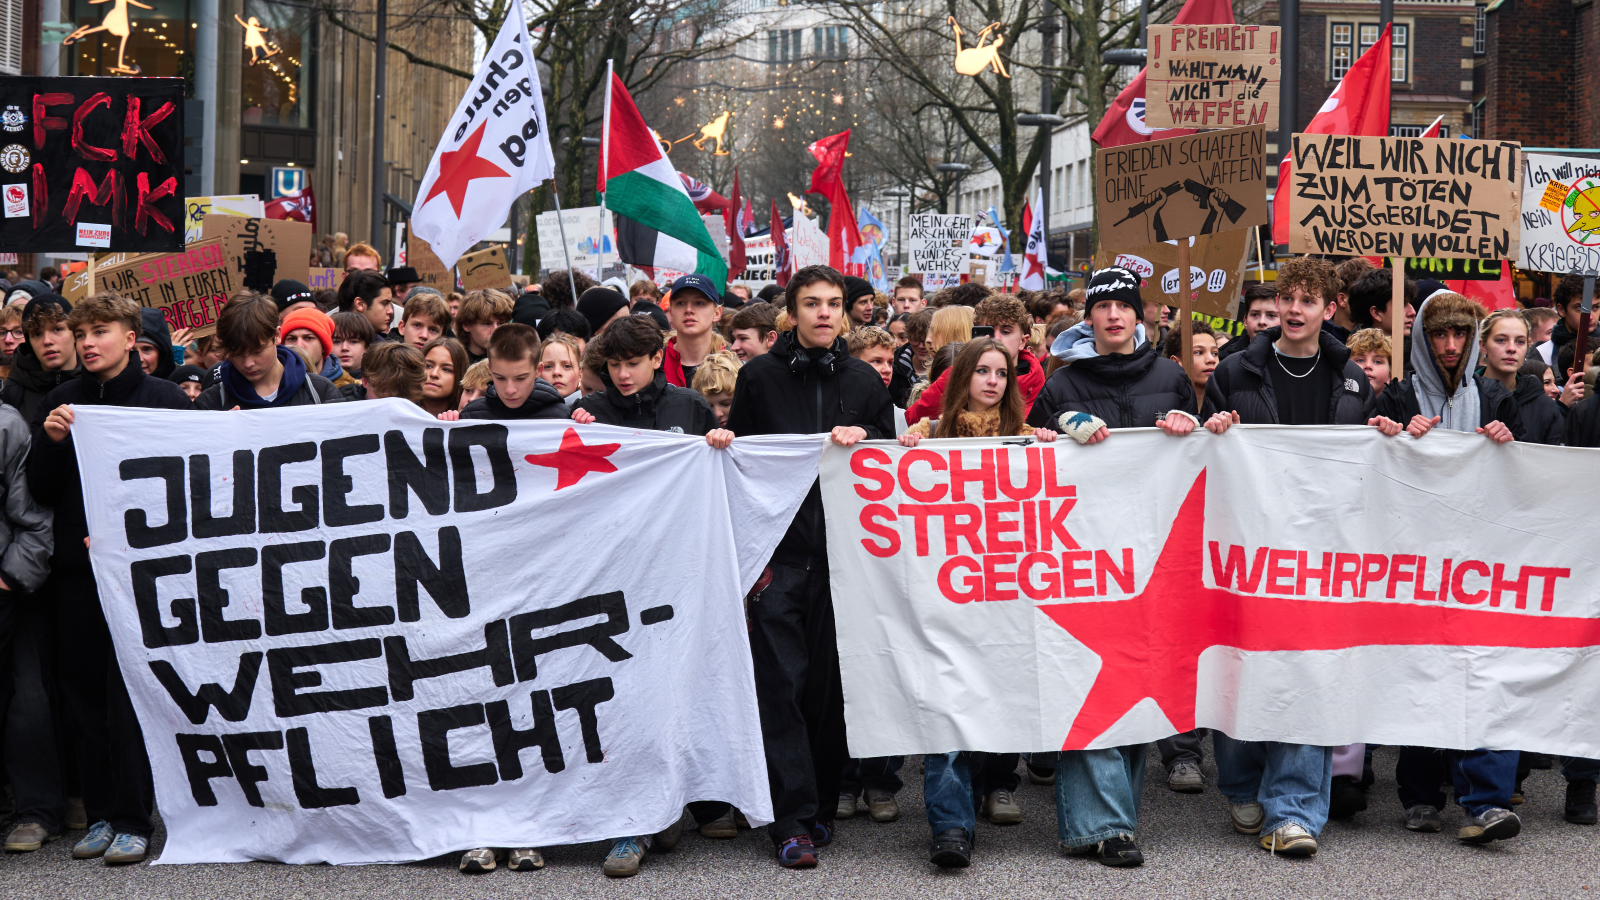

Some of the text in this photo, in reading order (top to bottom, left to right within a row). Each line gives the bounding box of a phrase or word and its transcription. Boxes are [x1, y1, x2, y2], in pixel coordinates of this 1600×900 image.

[1171, 26, 1260, 52] FREIHEIT
[1169, 80, 1230, 102] NICHT
[33, 92, 177, 166] FCK
[1169, 101, 1269, 125] WAFFEN
[1104, 128, 1264, 177] FRIEDEN SCHAFFEN
[1292, 134, 1522, 183] WEIL WIR NICHT
[278, 170, 300, 196] U
[1105, 157, 1263, 203] OHNE WAFFEN
[1295, 173, 1473, 206] ZUM TÖTEN
[1527, 159, 1552, 188] Ich
[1575, 164, 1600, 179] nich
[1550, 179, 1569, 192] KRIEG
[32, 162, 178, 237] IMK
[910, 227, 970, 240] ARSCH NICHT
[911, 214, 971, 229] MEIN GEHT
[1299, 203, 1500, 236] AUSGEBILDET
[913, 248, 967, 262] BUNDES-
[924, 239, 949, 250] ZUR
[1312, 225, 1510, 260] WERDEN WOLLEN
[102, 269, 142, 292] WIR
[141, 242, 224, 285] STERBEN
[1117, 255, 1153, 276] Töten
[1163, 271, 1205, 292] leren
[159, 283, 178, 303] IN
[183, 266, 232, 300] EUREN
[159, 291, 229, 332] RIEGEN
[119, 423, 519, 548] JUGEND
[849, 447, 1077, 502] SCHUL
[859, 498, 1078, 558] STREIK
[131, 525, 471, 649] GEGEN
[937, 547, 1135, 603] GEGEN
[1208, 540, 1571, 613] WEHRPFLICHT
[148, 590, 675, 725] WEHR-
[176, 676, 615, 809] PFLICHT
